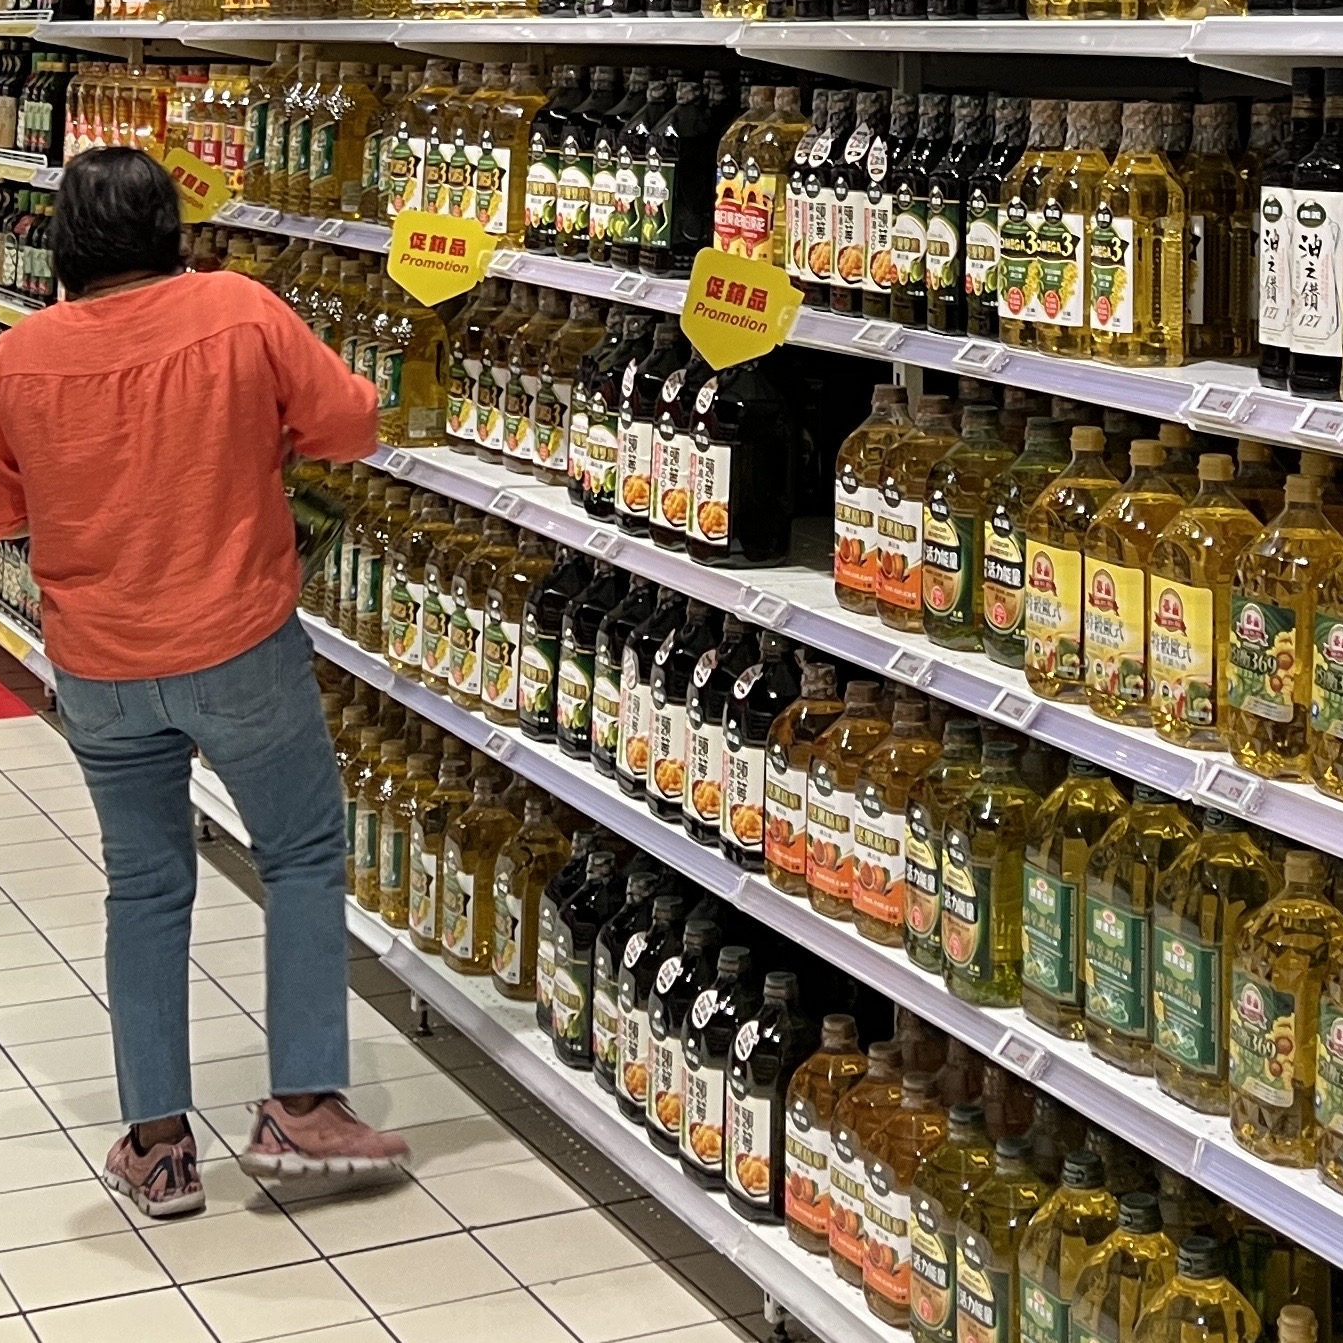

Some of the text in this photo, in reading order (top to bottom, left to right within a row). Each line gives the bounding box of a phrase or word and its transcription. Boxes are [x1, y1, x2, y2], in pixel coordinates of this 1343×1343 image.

[409, 230, 467, 258] 促銷品
[398, 252, 470, 275] Promotion
[704, 274, 769, 314] 促銷品
[692, 301, 769, 335] Promotion
